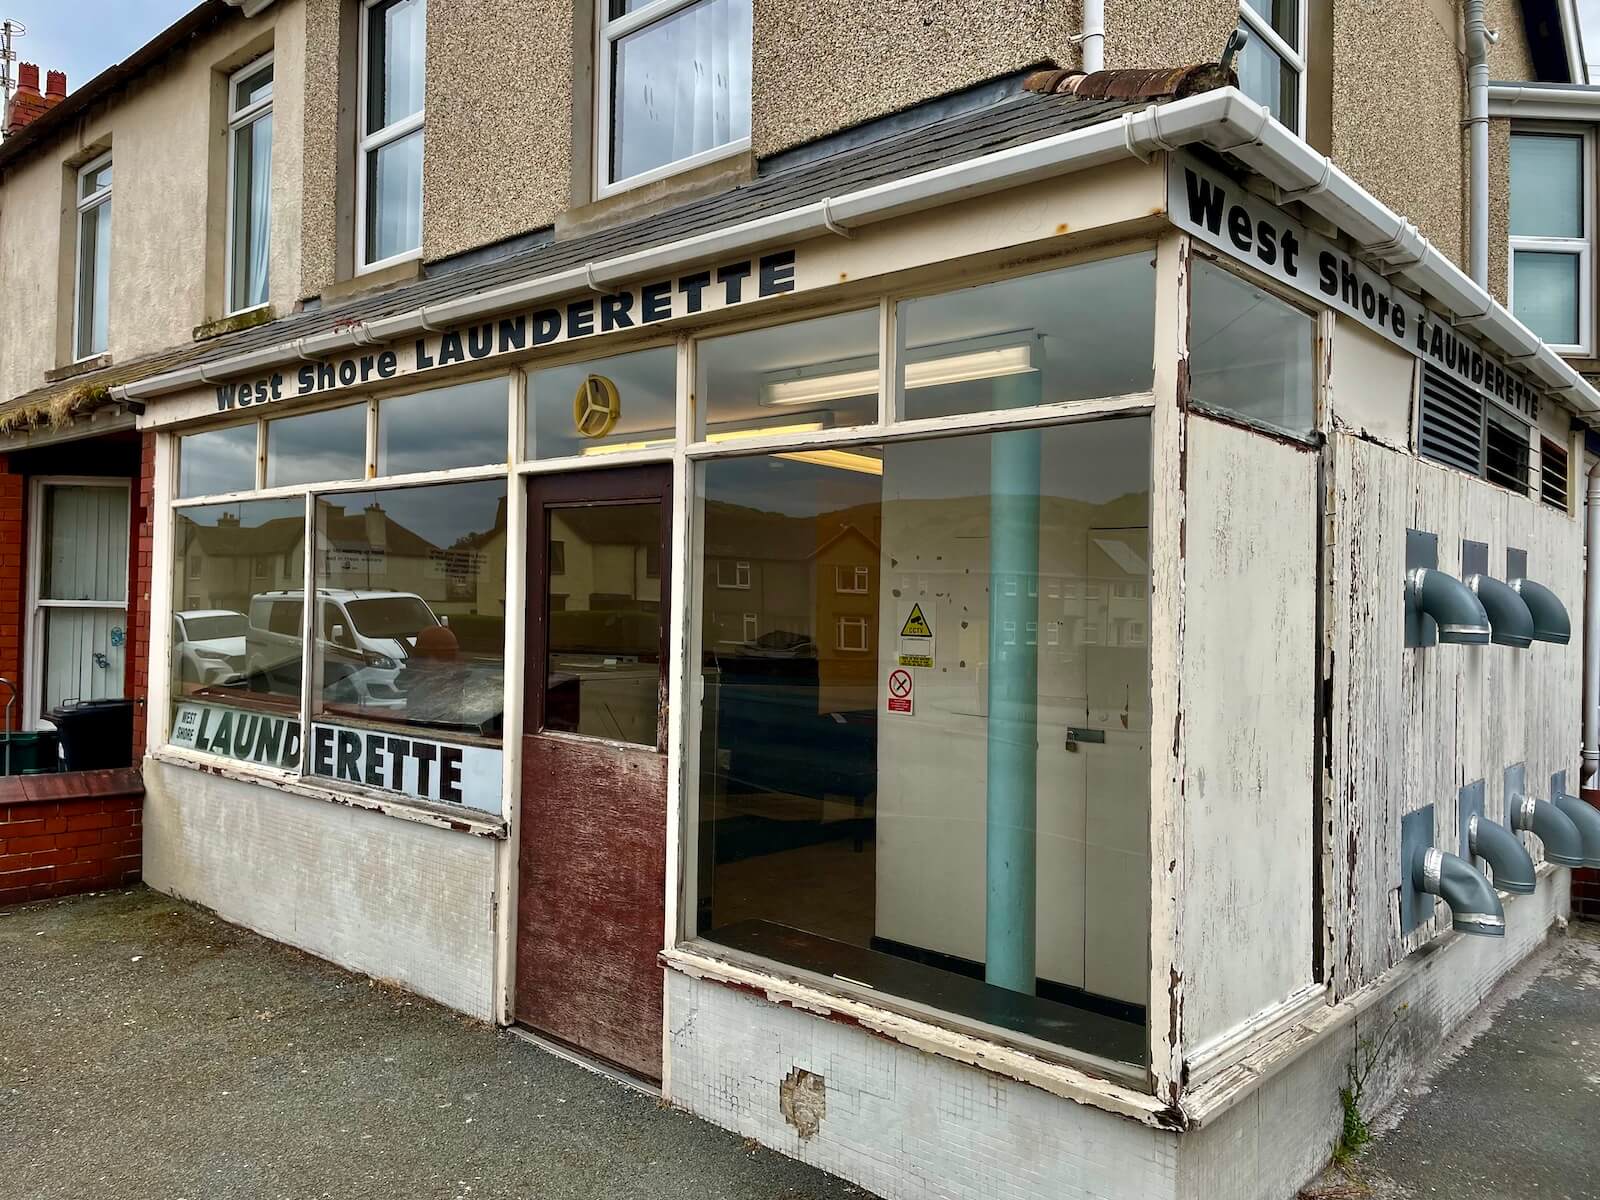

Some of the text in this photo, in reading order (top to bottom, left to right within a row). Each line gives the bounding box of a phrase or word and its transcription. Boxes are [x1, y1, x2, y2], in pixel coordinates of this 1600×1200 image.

[216, 249, 796, 411] West Shore LAUNDERETTE
[1185, 168, 1539, 421] West Shore LAUNDERETTE
[176, 726, 194, 742] SHORE
[181, 711, 197, 725] WEST
[195, 708, 463, 804] LAUNDERETTE
